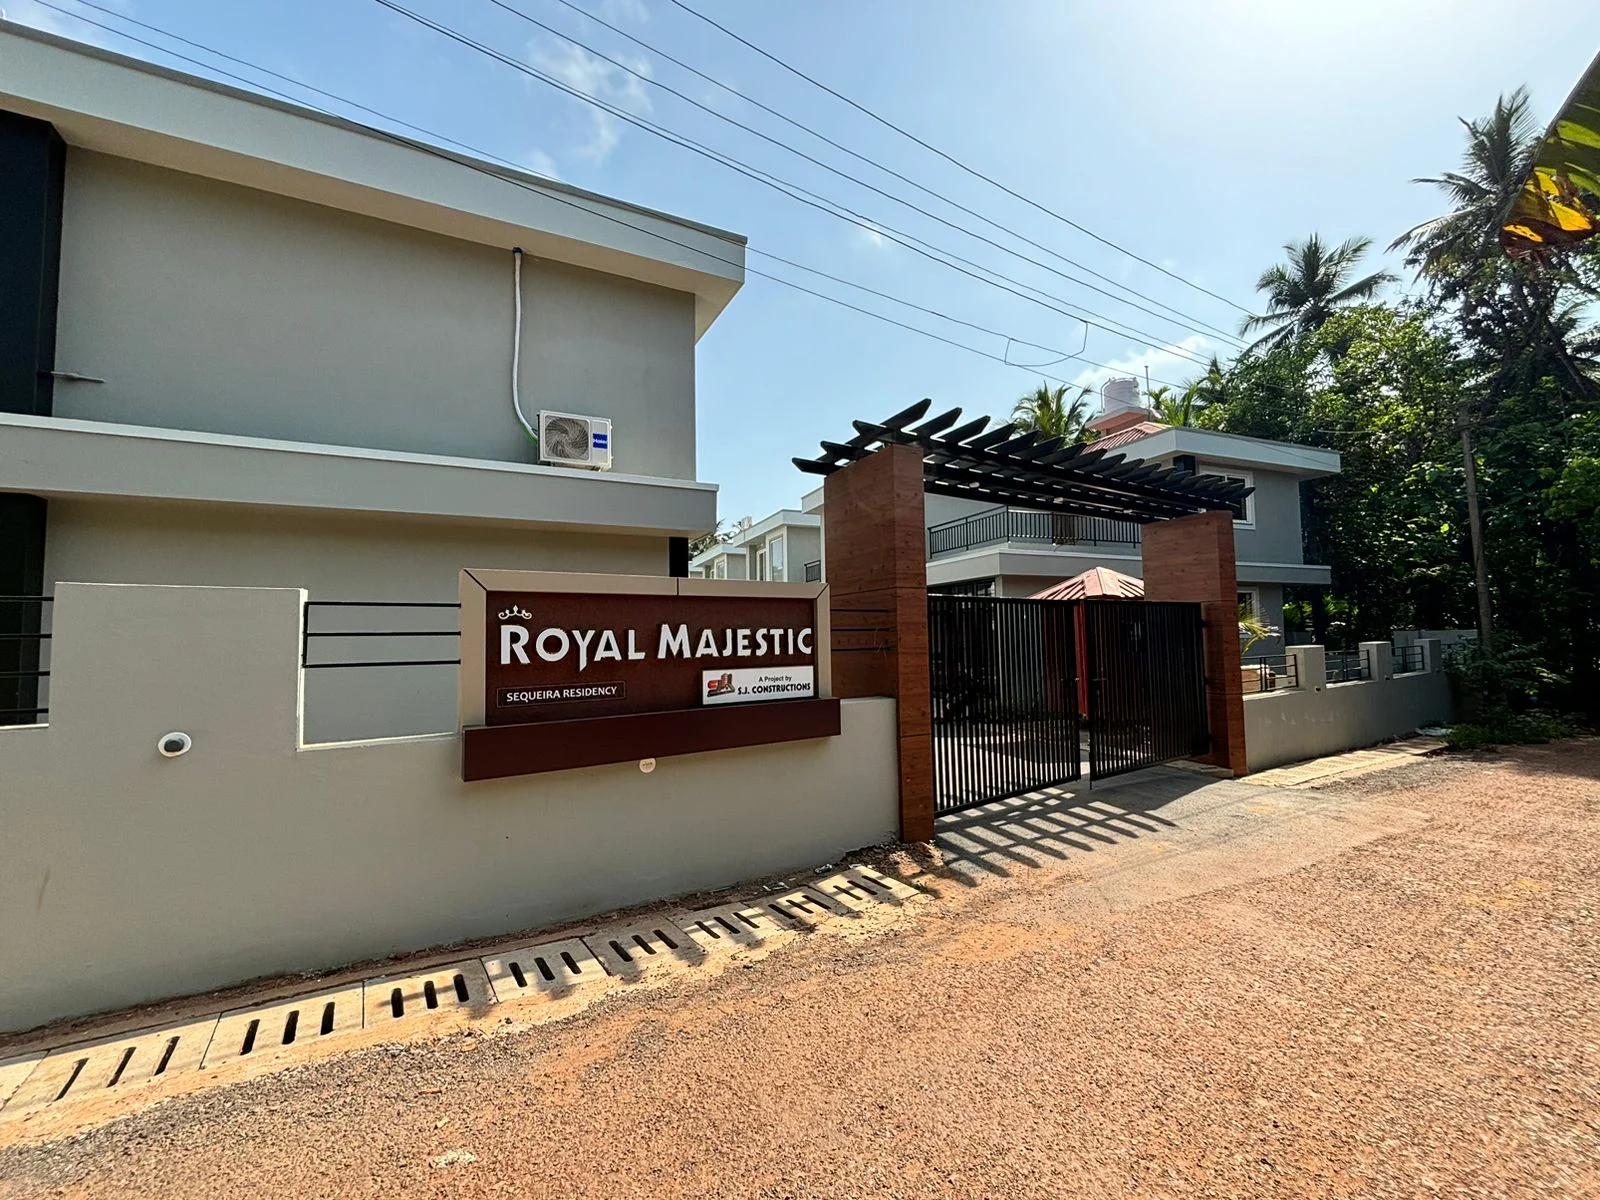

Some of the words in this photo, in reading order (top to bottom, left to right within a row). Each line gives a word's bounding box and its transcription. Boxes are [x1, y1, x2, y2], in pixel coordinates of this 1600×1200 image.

[500, 624, 646, 671] ROYAL
[657, 623, 812, 659] MAJESTIC
[764, 676, 784, 684] Project
[506, 690, 560, 703] SEQUEIRA
[563, 686, 617, 698] RESIDENCY
[738, 687, 750, 695] S.J.
[752, 682, 811, 694] CONSTRUCTIONS
